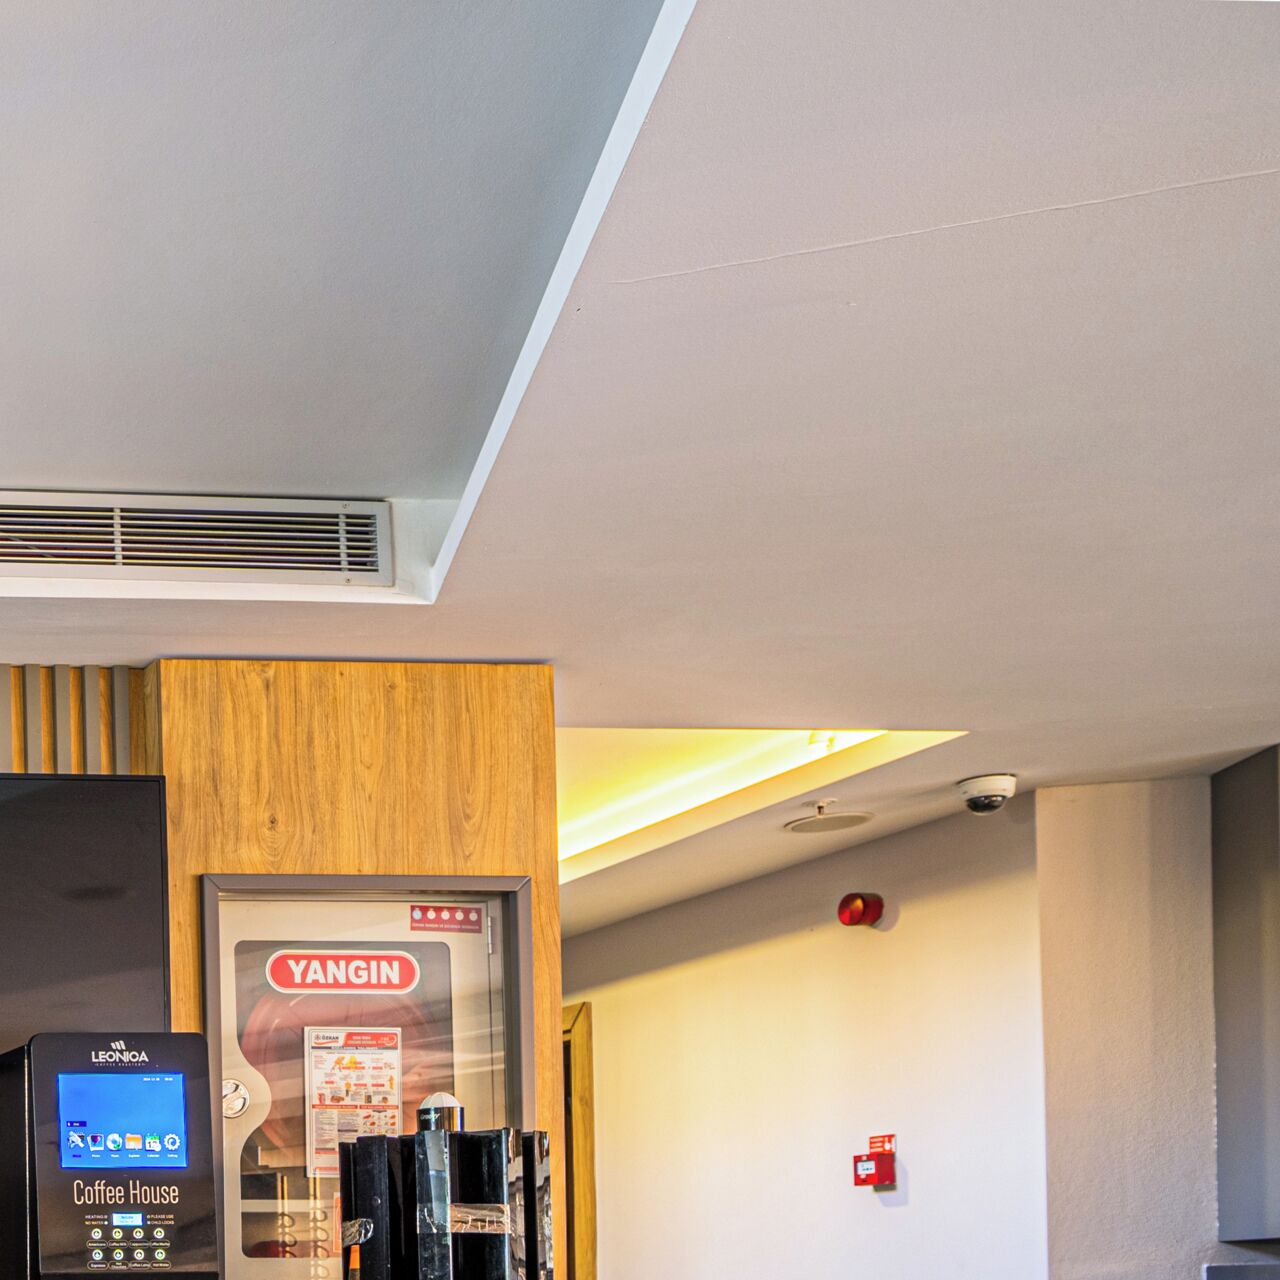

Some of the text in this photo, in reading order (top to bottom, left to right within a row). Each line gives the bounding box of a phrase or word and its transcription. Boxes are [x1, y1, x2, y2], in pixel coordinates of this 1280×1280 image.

[286, 959, 400, 984] YANGIN
[91, 1050, 150, 1063] LEONICA
[73, 1180, 179, 1205] Coffee House
